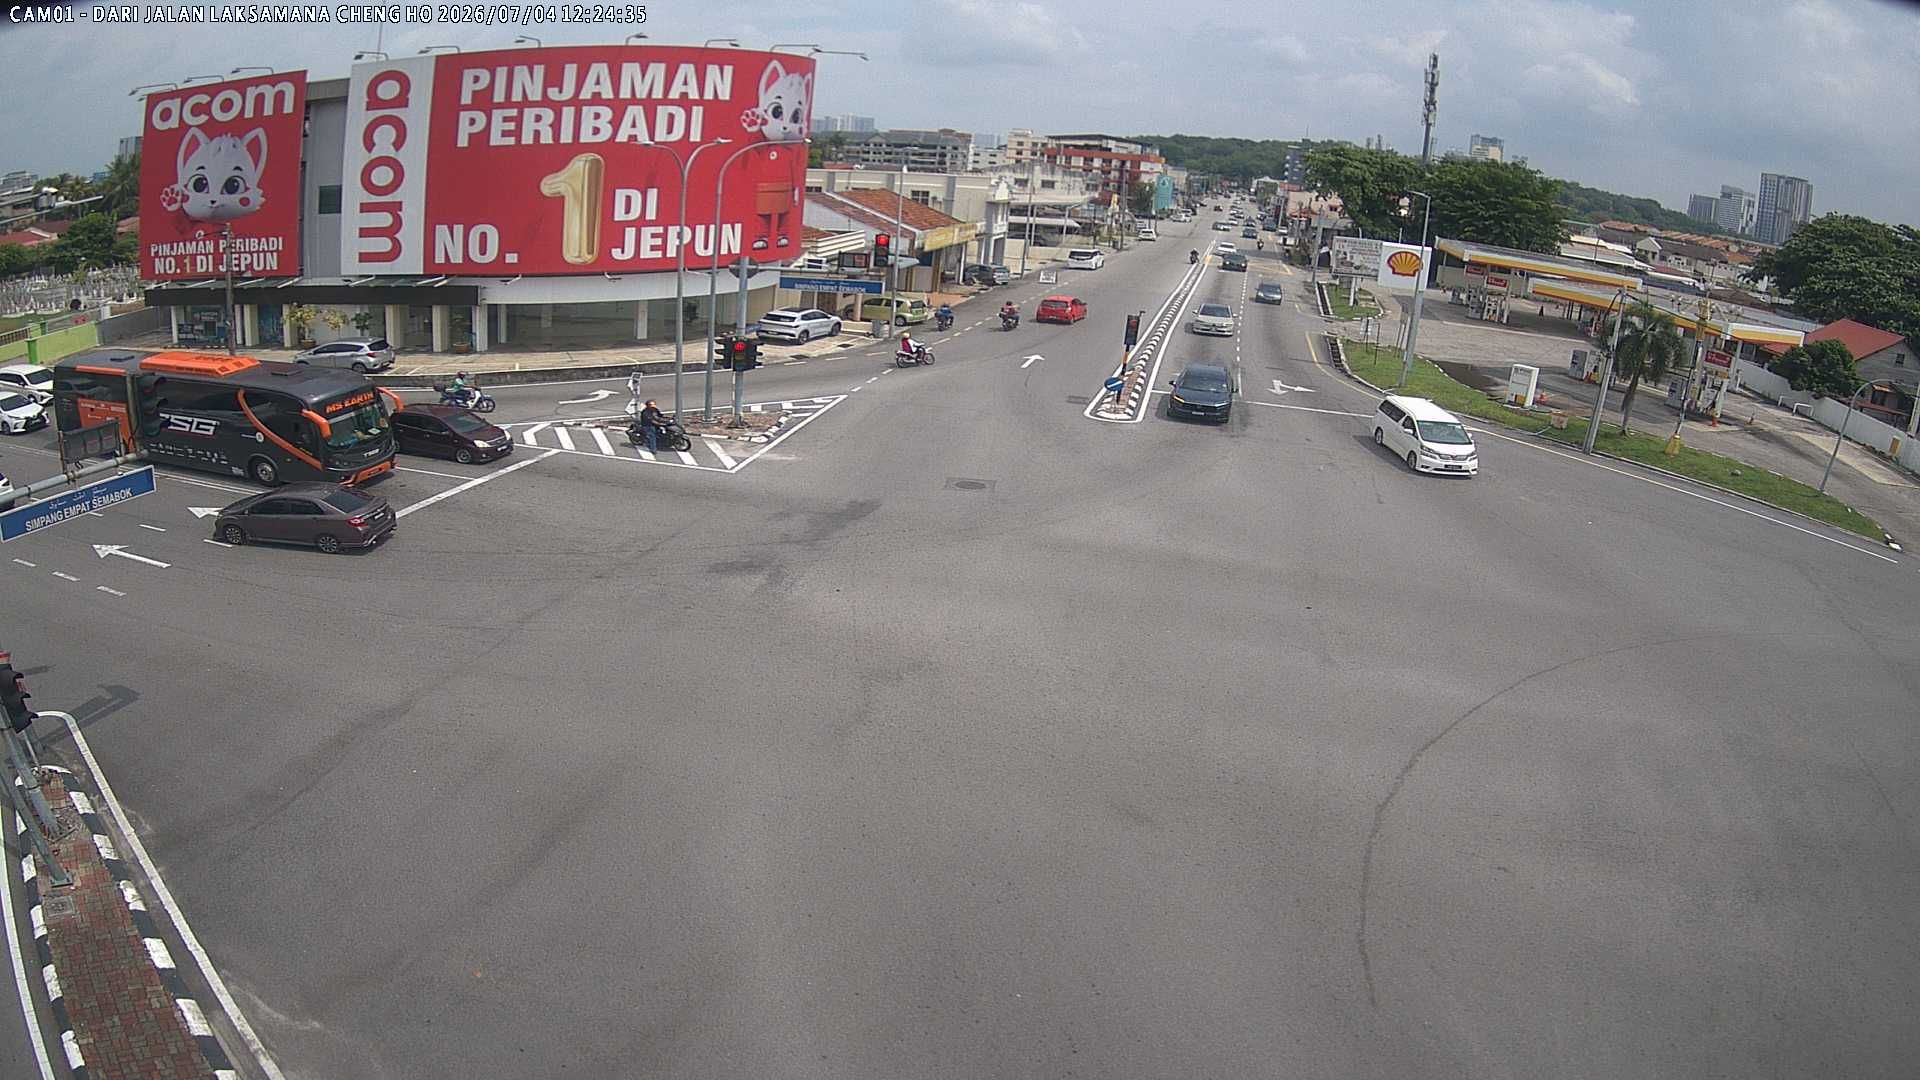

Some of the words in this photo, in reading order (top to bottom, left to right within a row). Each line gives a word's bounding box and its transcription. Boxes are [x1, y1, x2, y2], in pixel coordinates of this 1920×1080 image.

[460, 62, 734, 105] PINJAMAN
[152, 81, 295, 131] acom
[457, 105, 703, 147] PERIBADI
[359, 69, 411, 264] acom
[434, 223, 519, 264] NO.
[540, 152, 605, 265] 1
[613, 188, 658, 222] DI
[151, 240, 213, 256] PINJAMAN
[611, 223, 743, 260] JEPUN
[154, 257, 181, 275] NO.
[197, 255, 213, 272] DI
[25, 509, 64, 531] SIMPANG
[64, 502, 91, 520] EMPAT
[91, 487, 133, 508] SEMABOK
